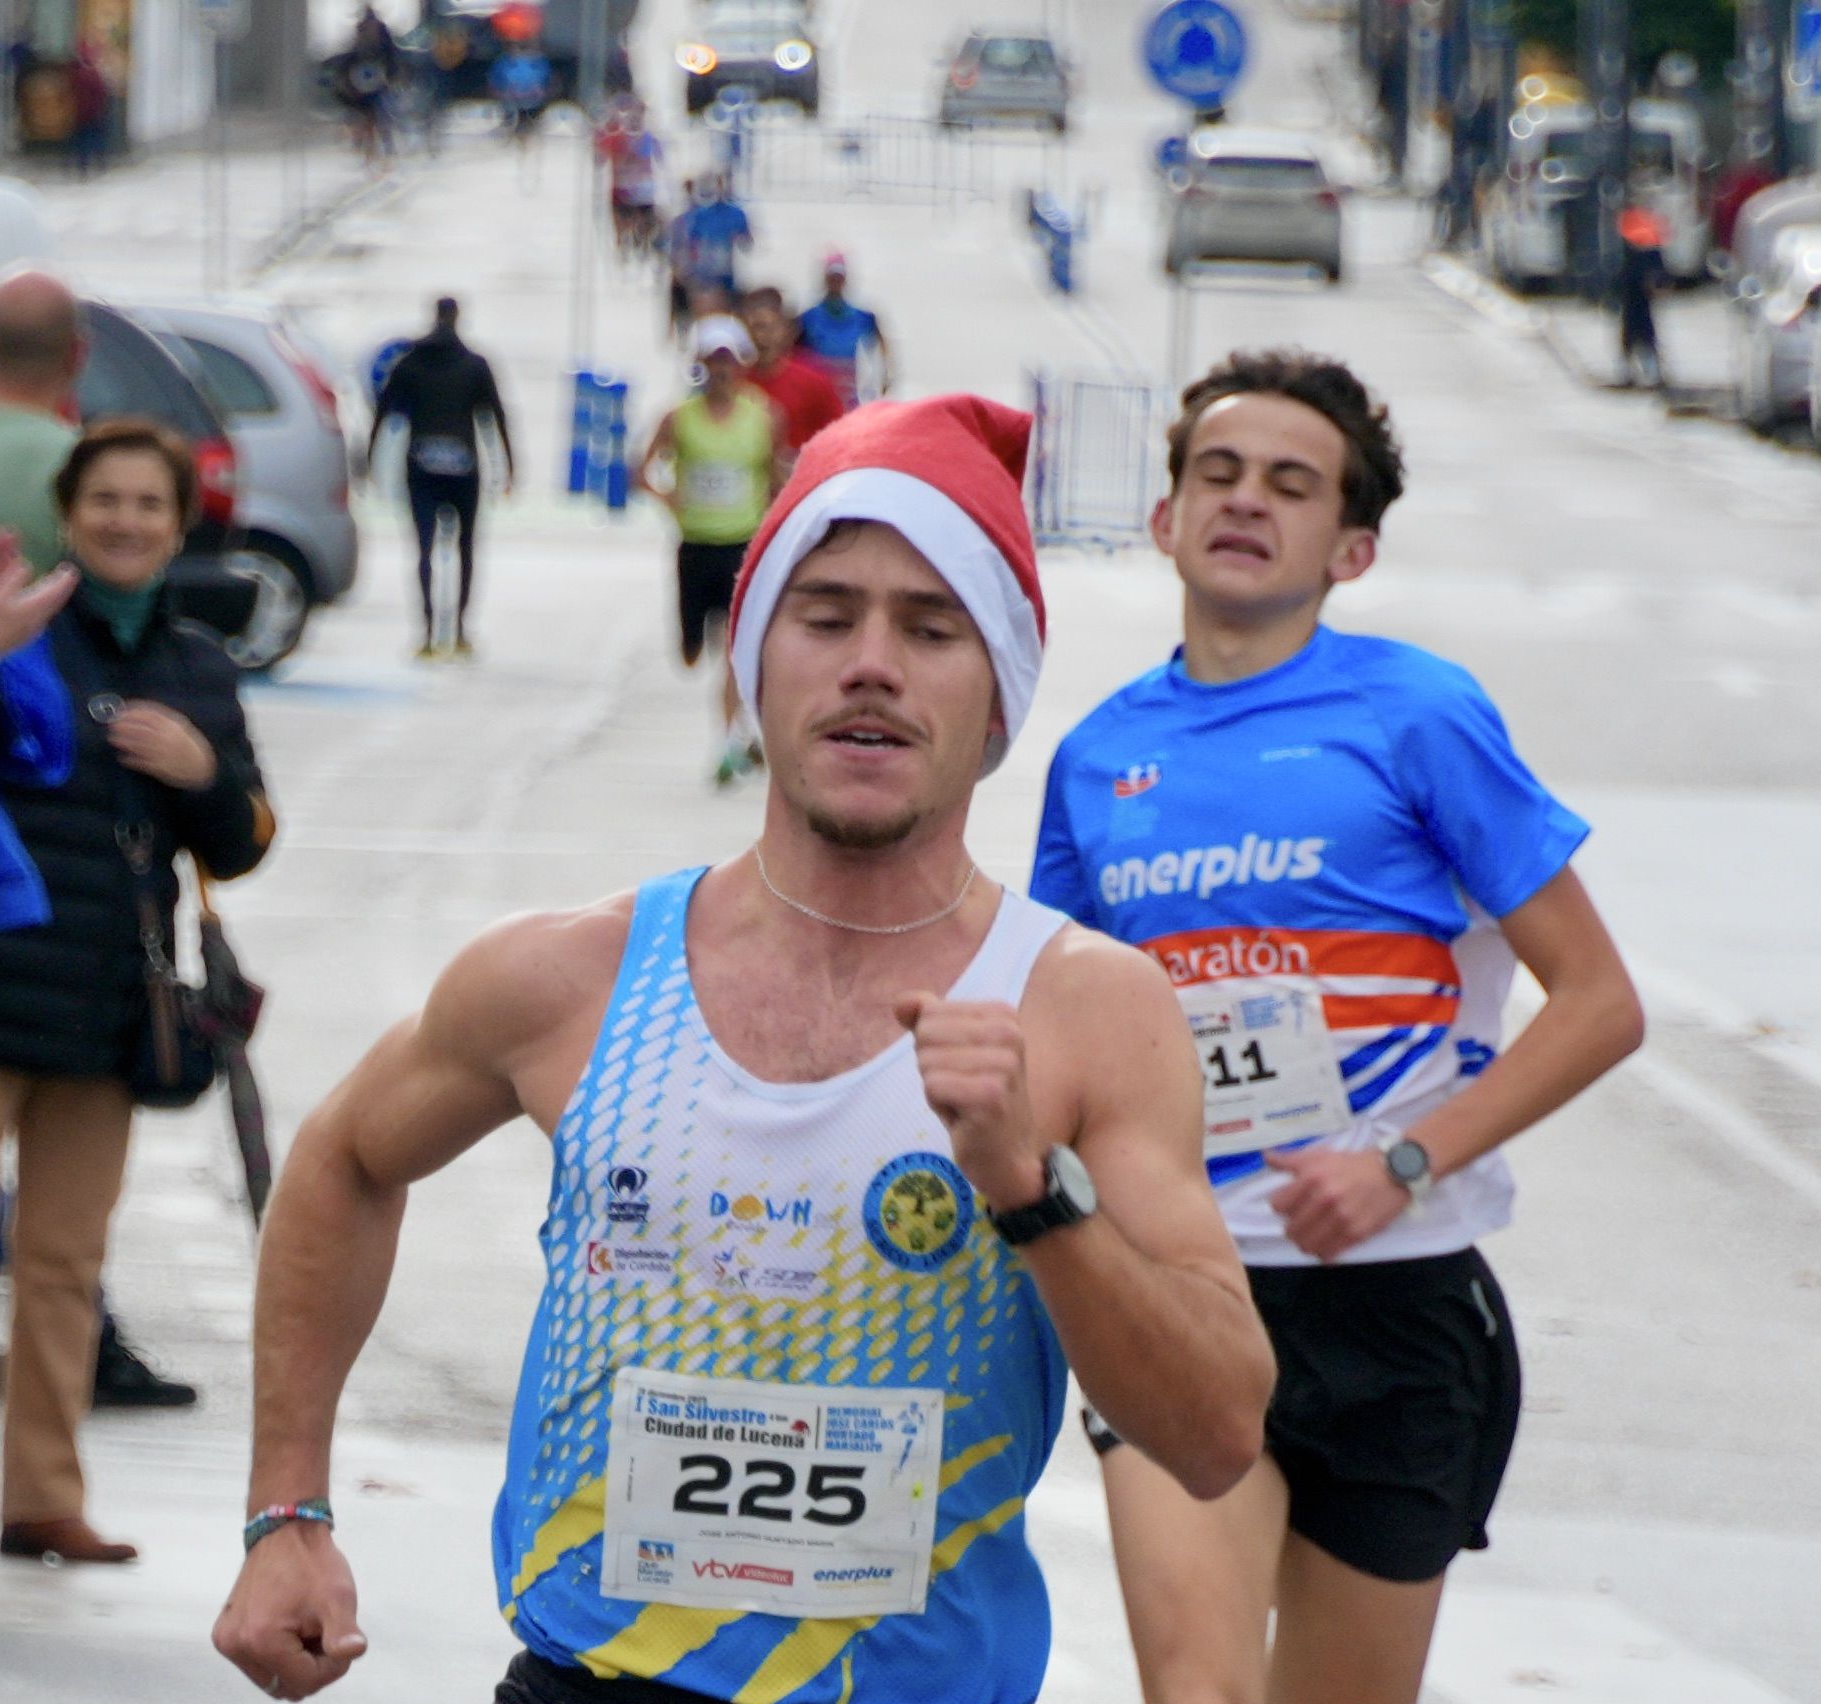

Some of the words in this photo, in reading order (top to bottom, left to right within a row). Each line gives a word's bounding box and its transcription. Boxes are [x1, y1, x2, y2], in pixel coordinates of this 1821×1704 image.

[1100, 833, 1328, 906] enerplus
[1150, 930, 1309, 984] aratón
[1203, 1040, 1279, 1087] 11
[709, 1191, 812, 1227] DOWN
[647, 1398, 681, 1418] San
[684, 1402, 767, 1425] Silvestre
[645, 1417, 708, 1441] Ciudad
[712, 1424, 736, 1442] de
[740, 1426, 806, 1449] Lucena
[672, 1455, 867, 1526] 225
[692, 1558, 741, 1581] vtv
[813, 1565, 894, 1583] enerplus
